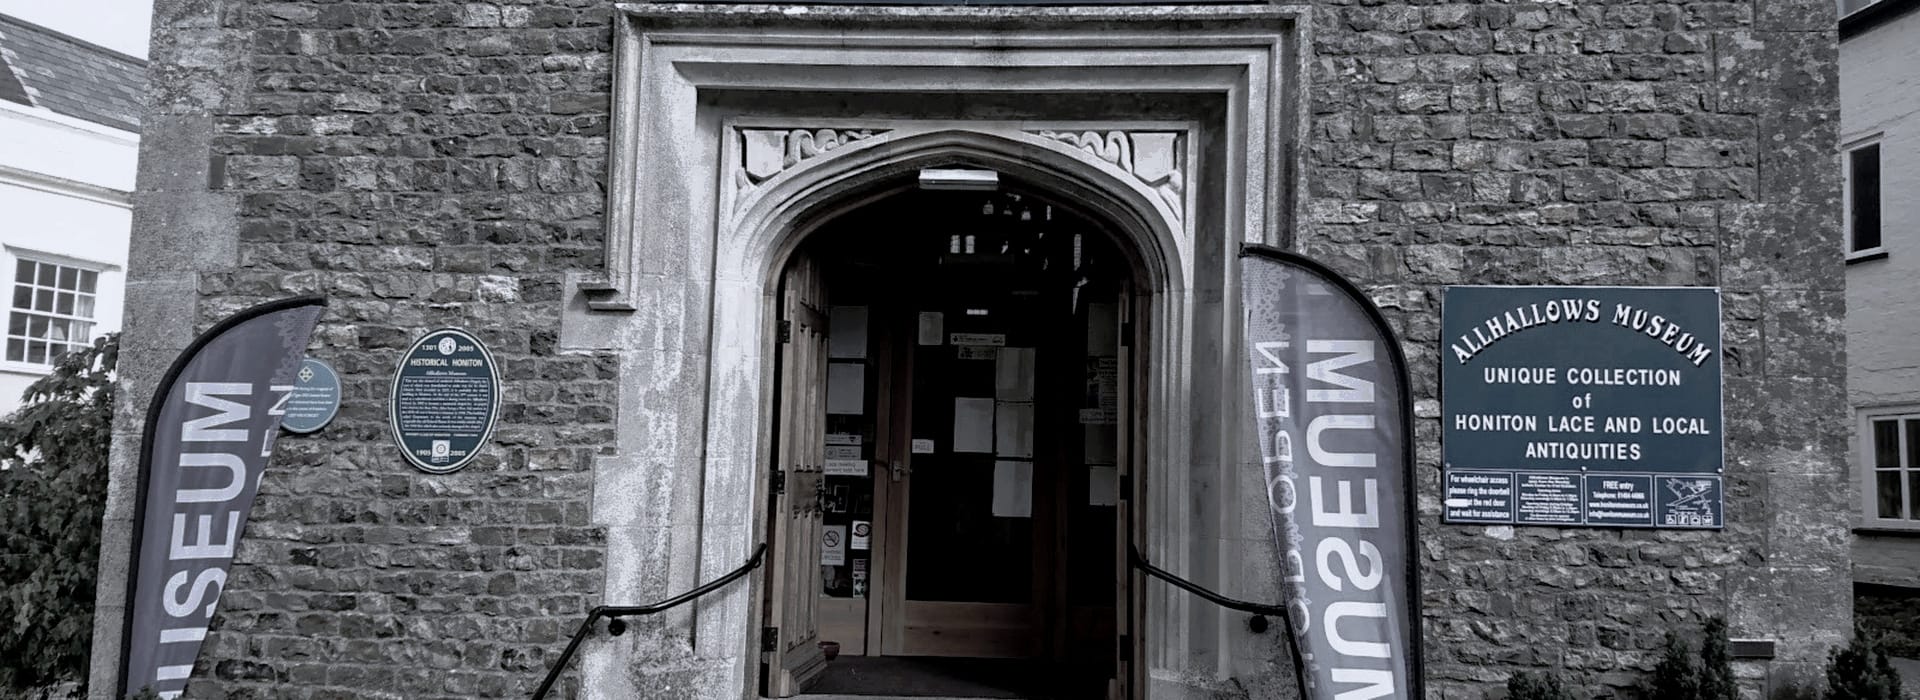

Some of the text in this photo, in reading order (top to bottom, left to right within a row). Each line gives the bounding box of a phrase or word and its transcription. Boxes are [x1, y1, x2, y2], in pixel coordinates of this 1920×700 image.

[1451, 298, 1712, 367] ALLHALLOWS MUSEUM
[410, 358, 483, 367] HISTORICAL HONITON
[1484, 367, 1680, 386] UNIQUE COLLECTION
[1572, 392, 1591, 409] of
[1455, 414, 1710, 435] HONITON LACE AND LOCAL
[1525, 442, 1641, 461] ANTIQUITIES
[1450, 475, 1460, 483] For
[1461, 475, 1489, 483] wheelchair
[1603, 480, 1634, 491] FREE entry
[1449, 487, 1510, 496] please ring the doorbell
[1450, 509, 1509, 518] and wait for assistance
[156, 381, 253, 700] USEUM
